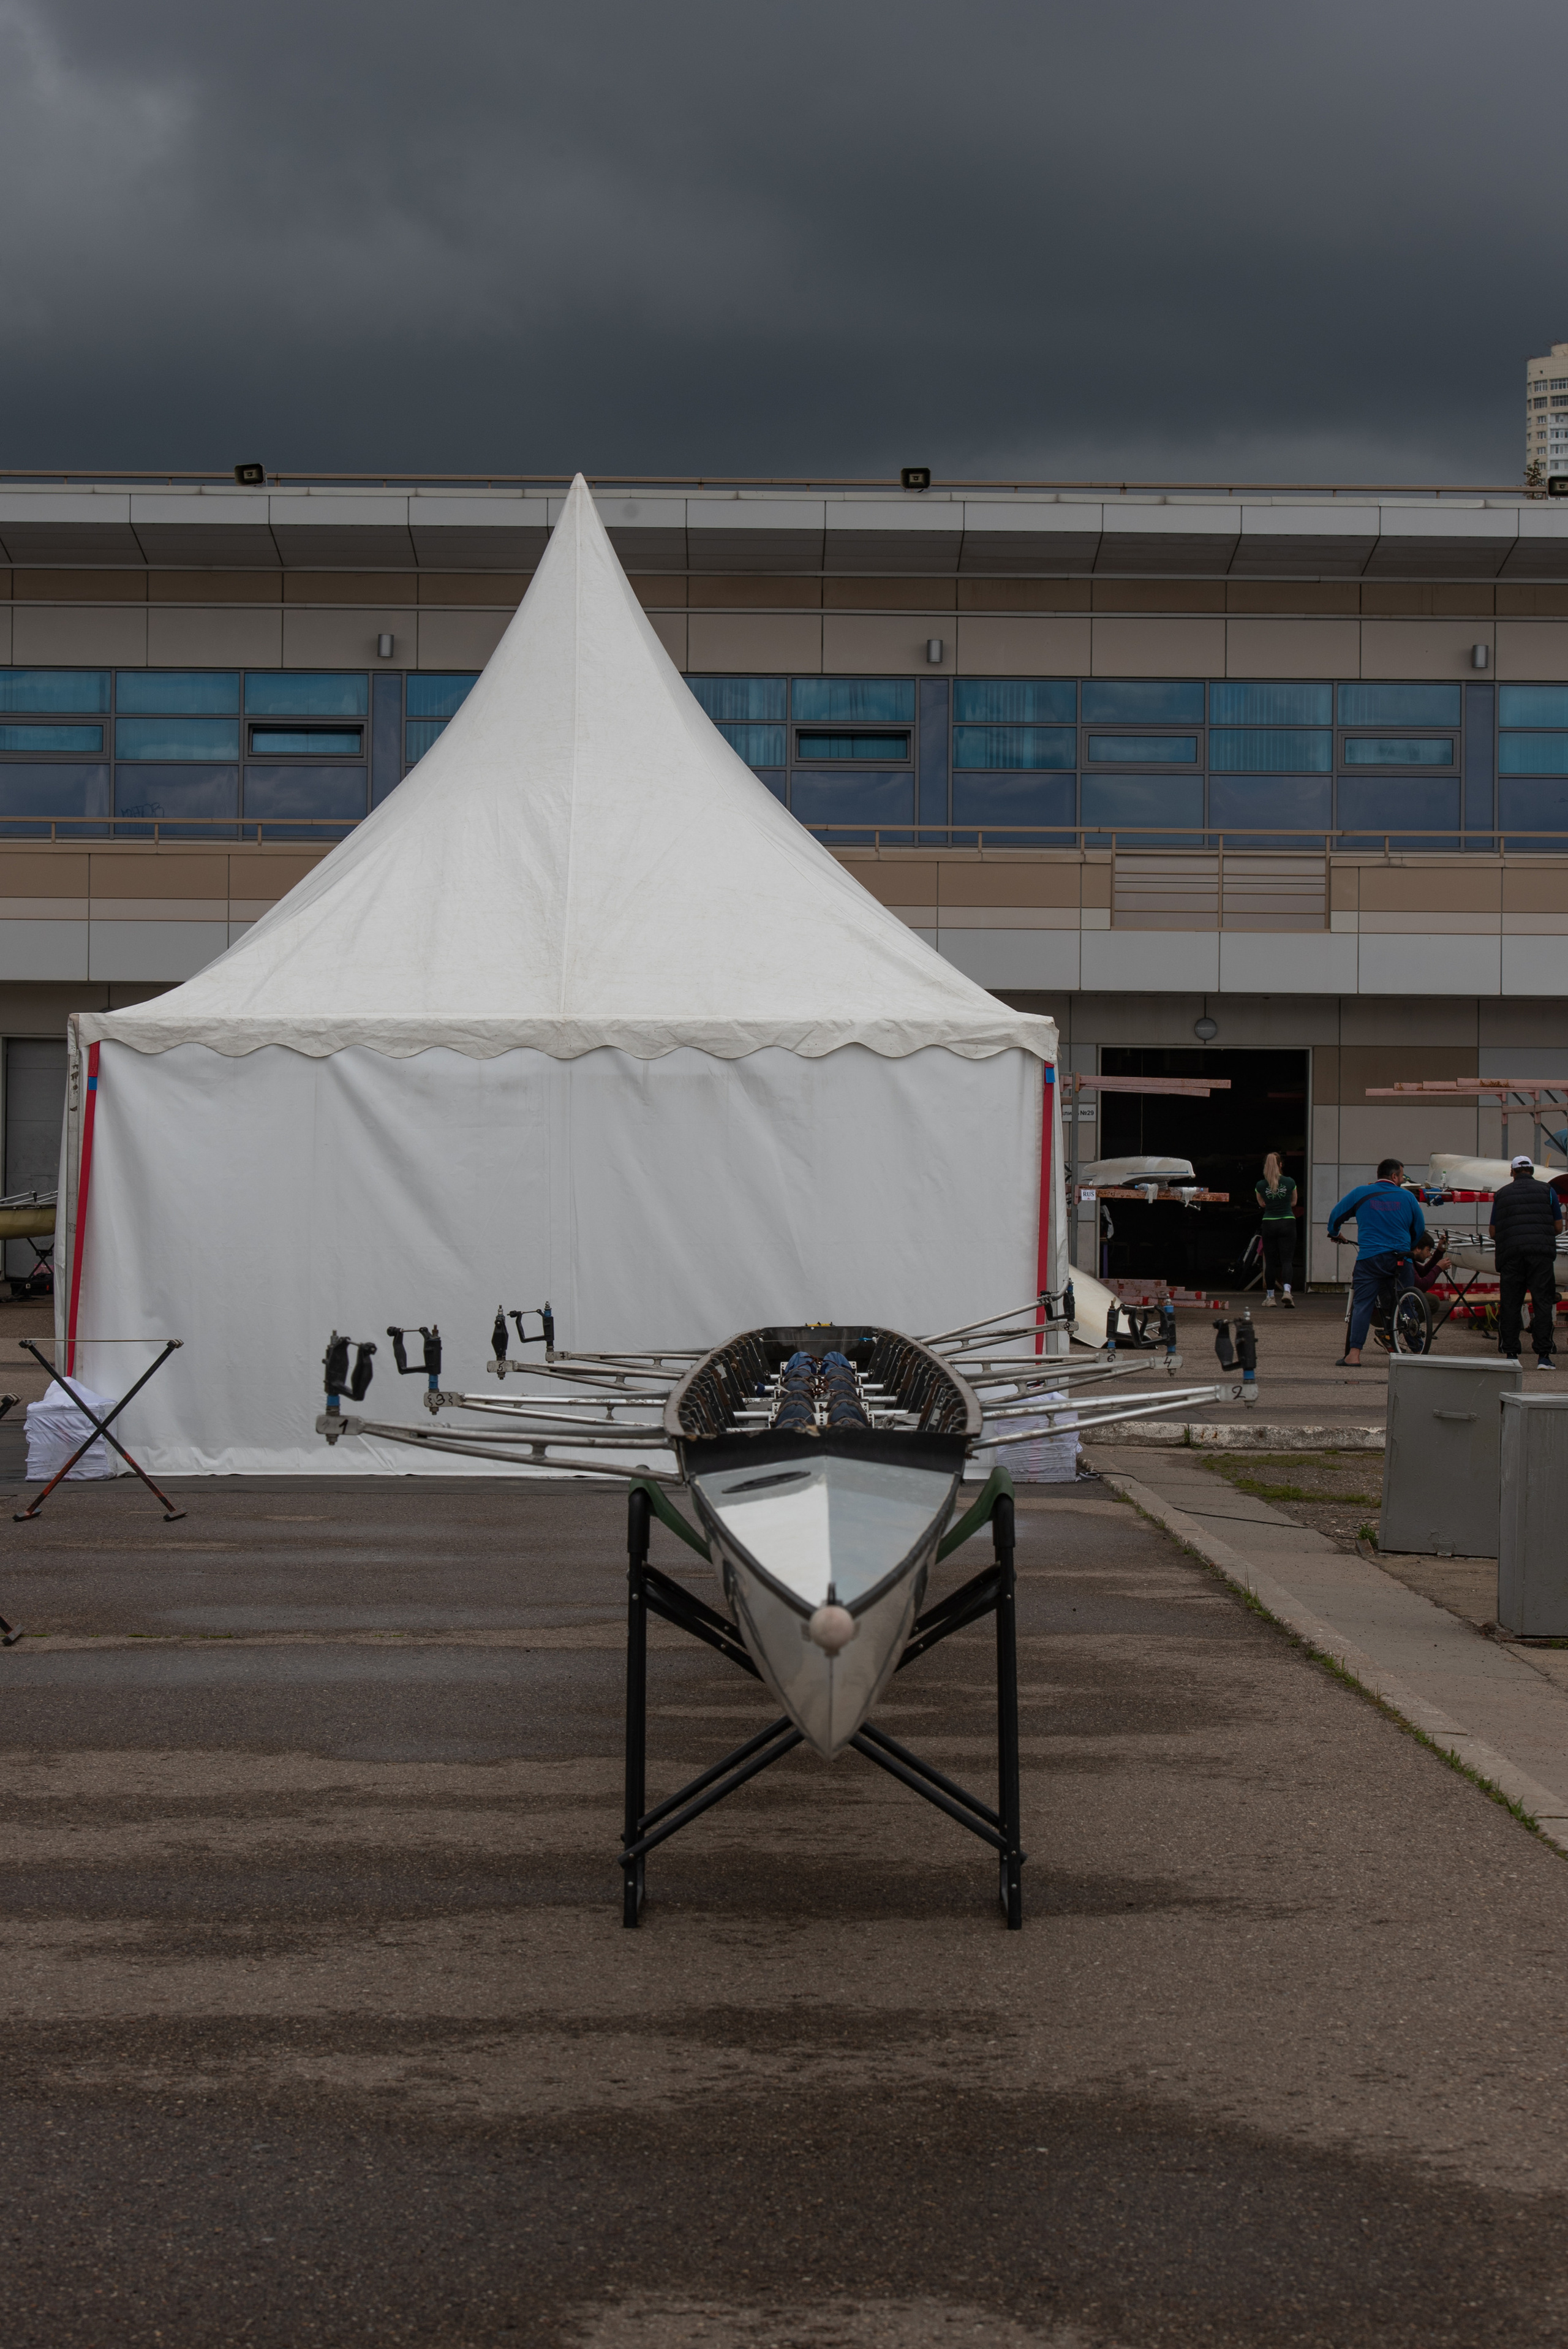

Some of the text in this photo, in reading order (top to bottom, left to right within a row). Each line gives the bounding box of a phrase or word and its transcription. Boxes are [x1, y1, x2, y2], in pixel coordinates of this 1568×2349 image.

[497, 1361, 504, 1372] 5
[1163, 1356, 1172, 1367] 4
[1232, 1385, 1246, 1400] 2
[339, 1419, 349, 1434] 1
